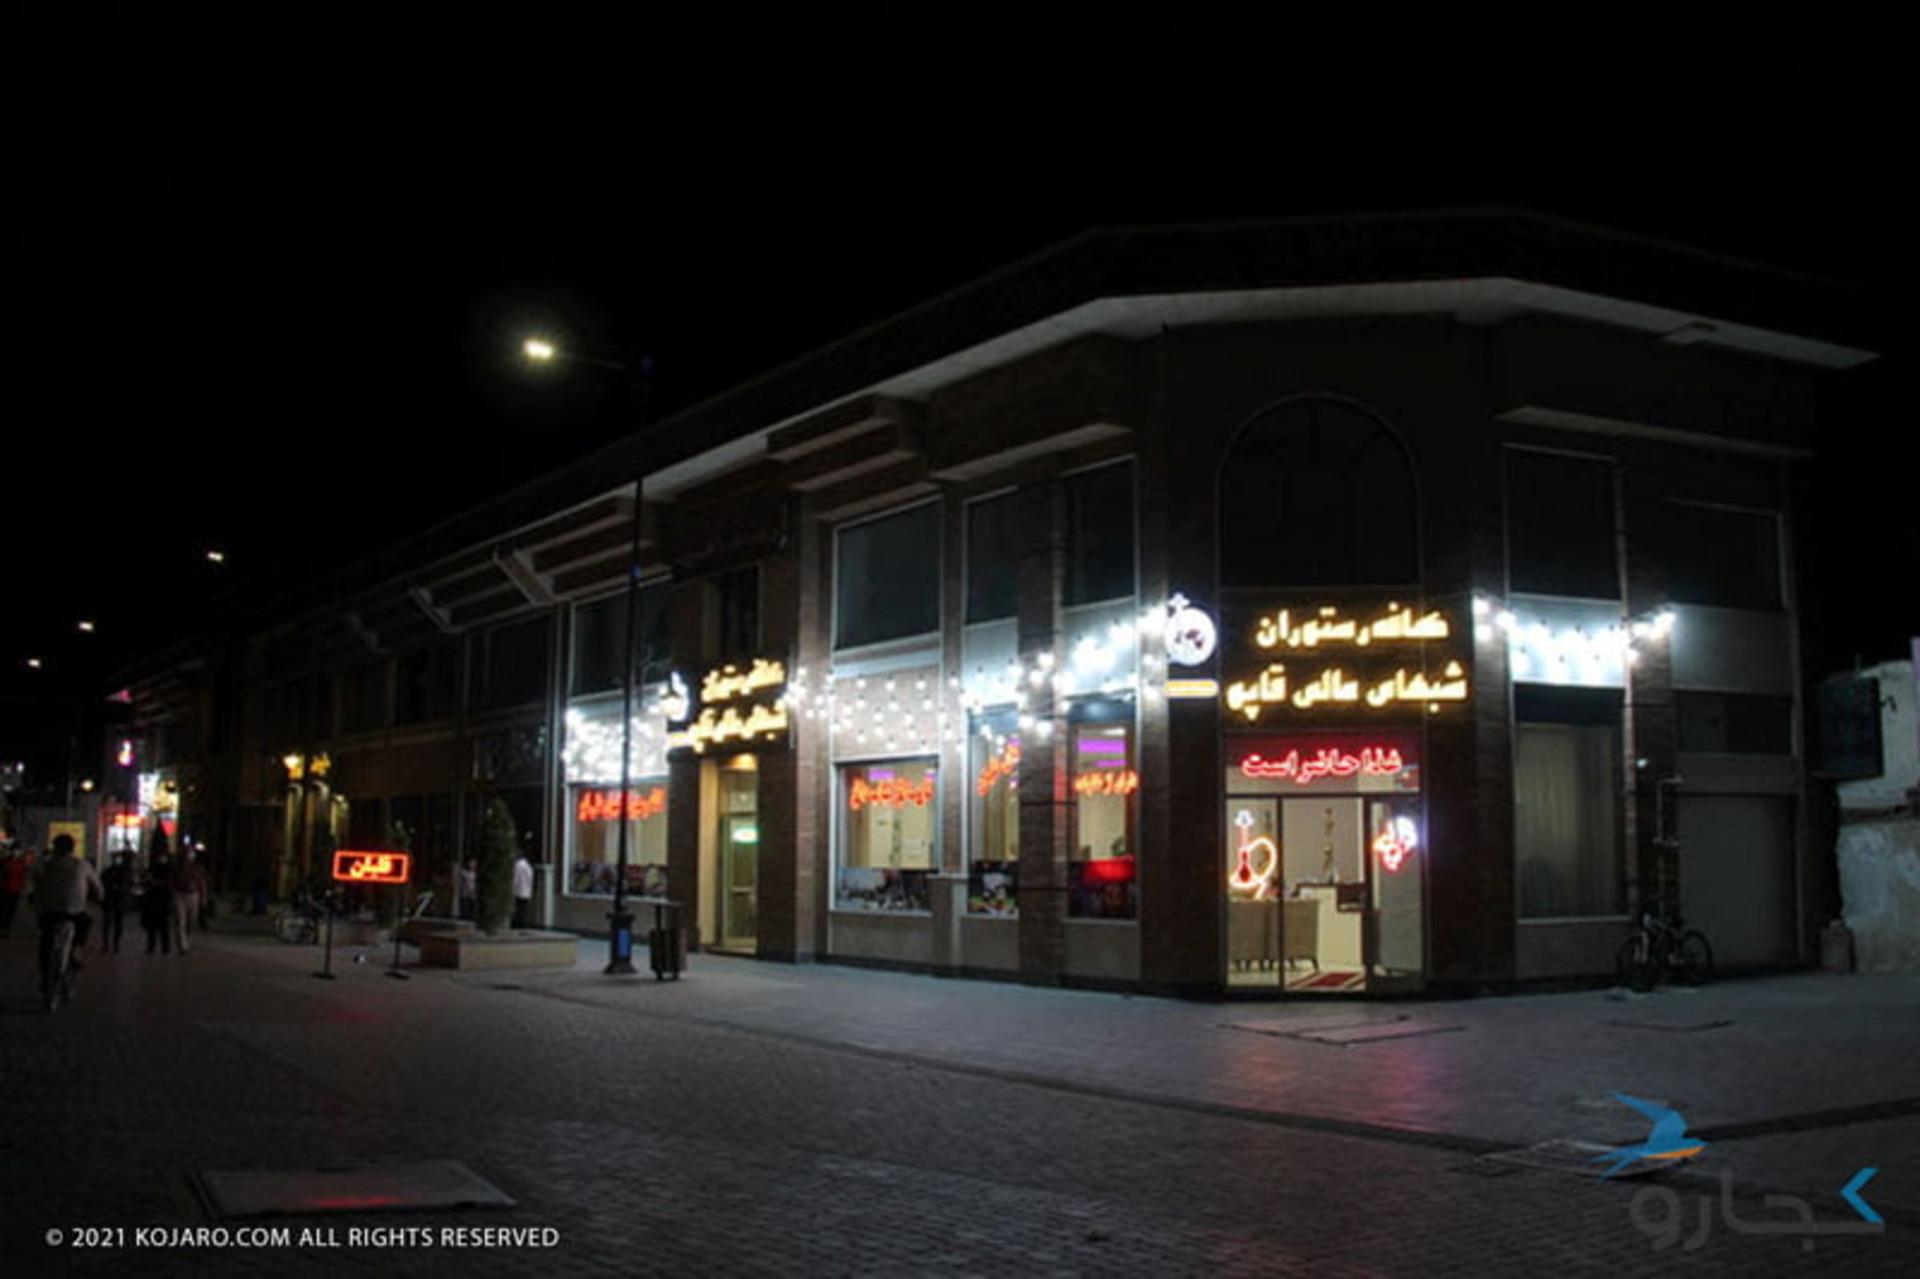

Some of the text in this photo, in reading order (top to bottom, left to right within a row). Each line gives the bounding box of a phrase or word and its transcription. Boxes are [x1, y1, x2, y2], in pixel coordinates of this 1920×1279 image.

[1257, 603, 1448, 646] کافه رستوران
[1227, 661, 1467, 720] شبهای عالی قاپو
[1241, 750, 1298, 778] است
[1296, 749, 1362, 784] حاضر
